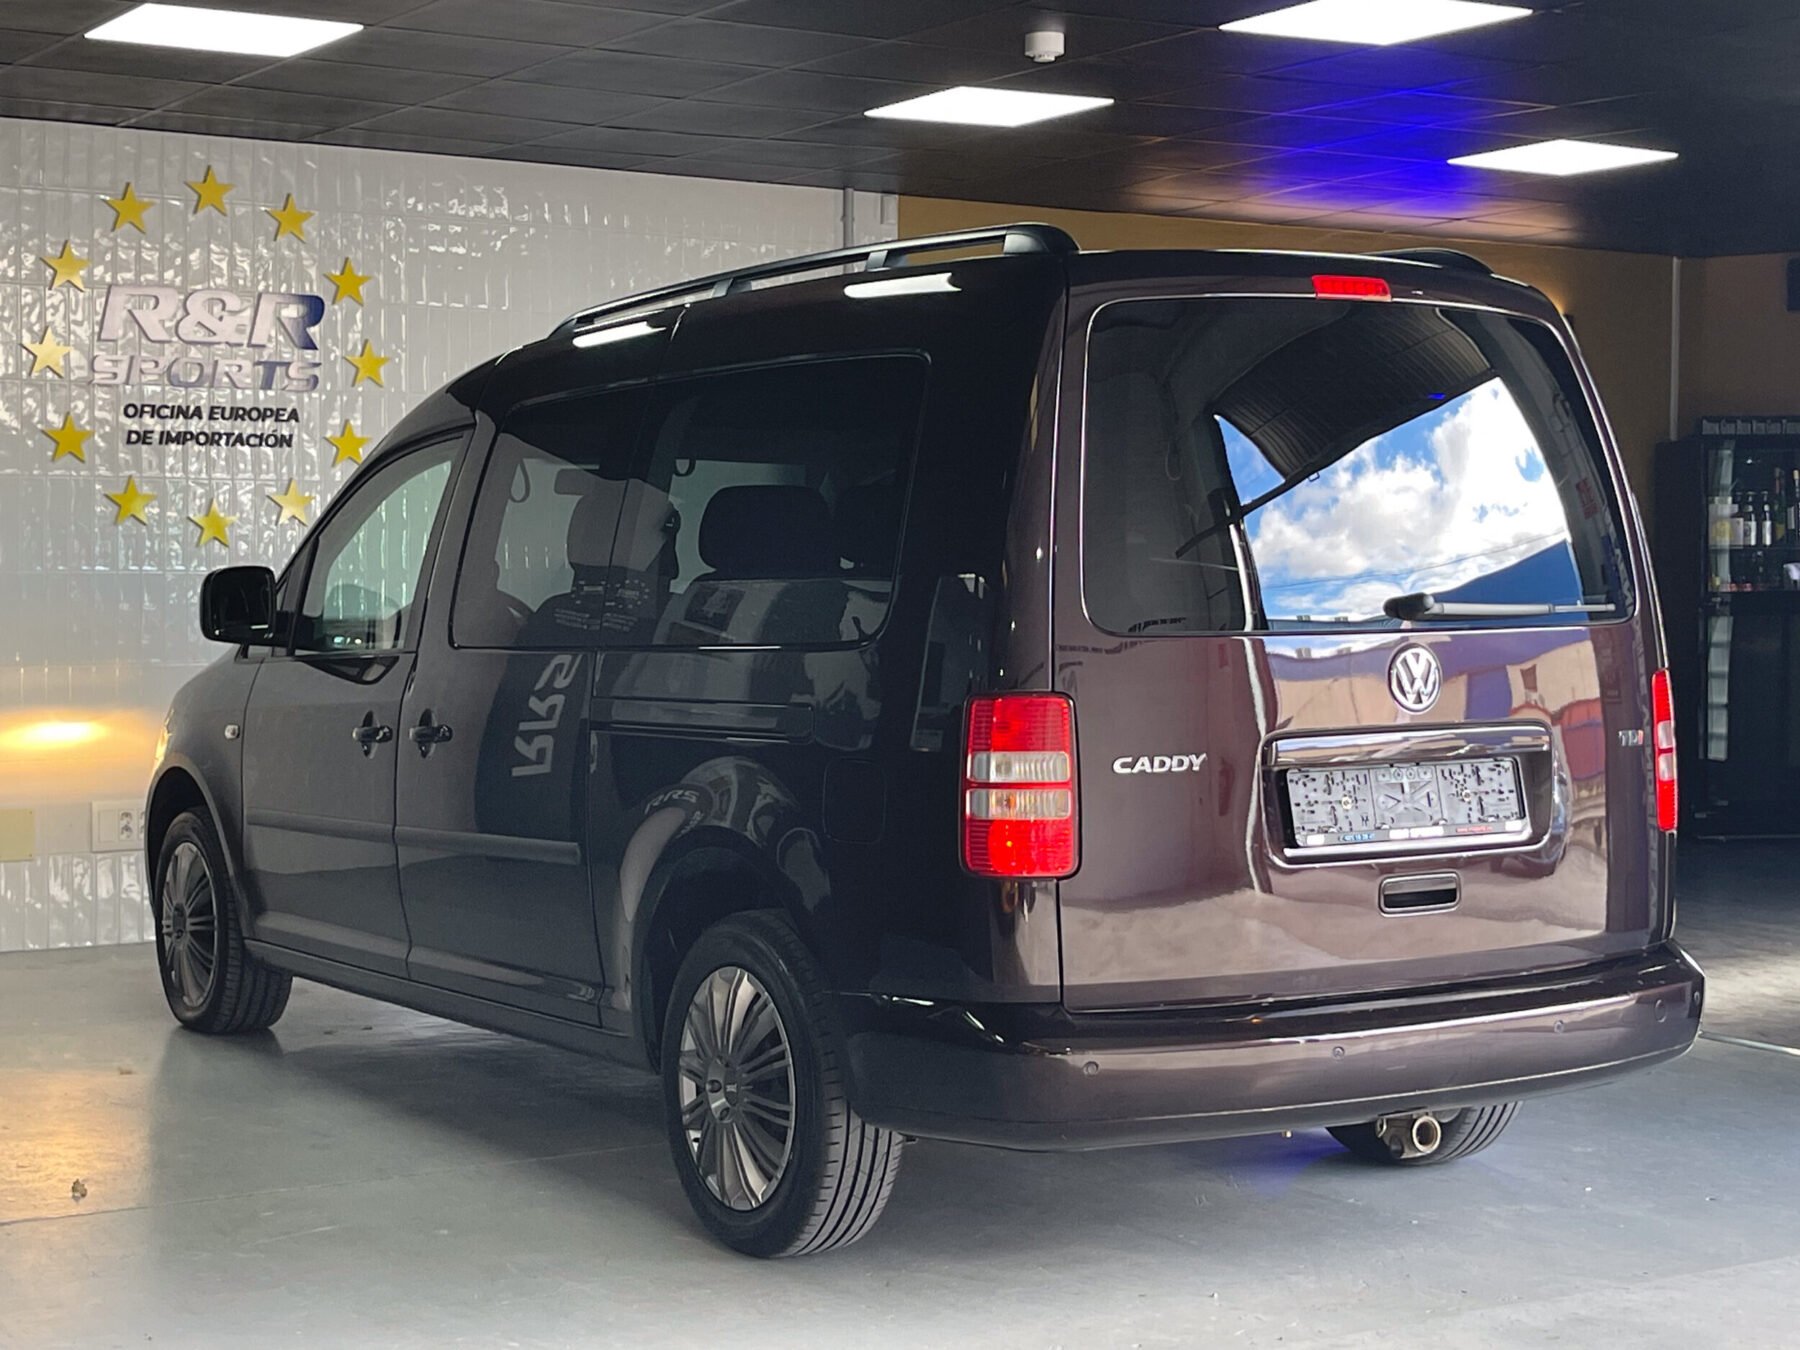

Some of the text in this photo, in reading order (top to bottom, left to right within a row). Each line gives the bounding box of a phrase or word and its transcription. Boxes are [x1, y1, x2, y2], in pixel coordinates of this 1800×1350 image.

[97, 284, 326, 350] R&R
[89, 354, 322, 391] SPORTS
[123, 403, 300, 423] OFICINA EUROPEA
[126, 429, 294, 448] DE IMPORTACIÓN
[1112, 753, 1207, 774] CADDY
